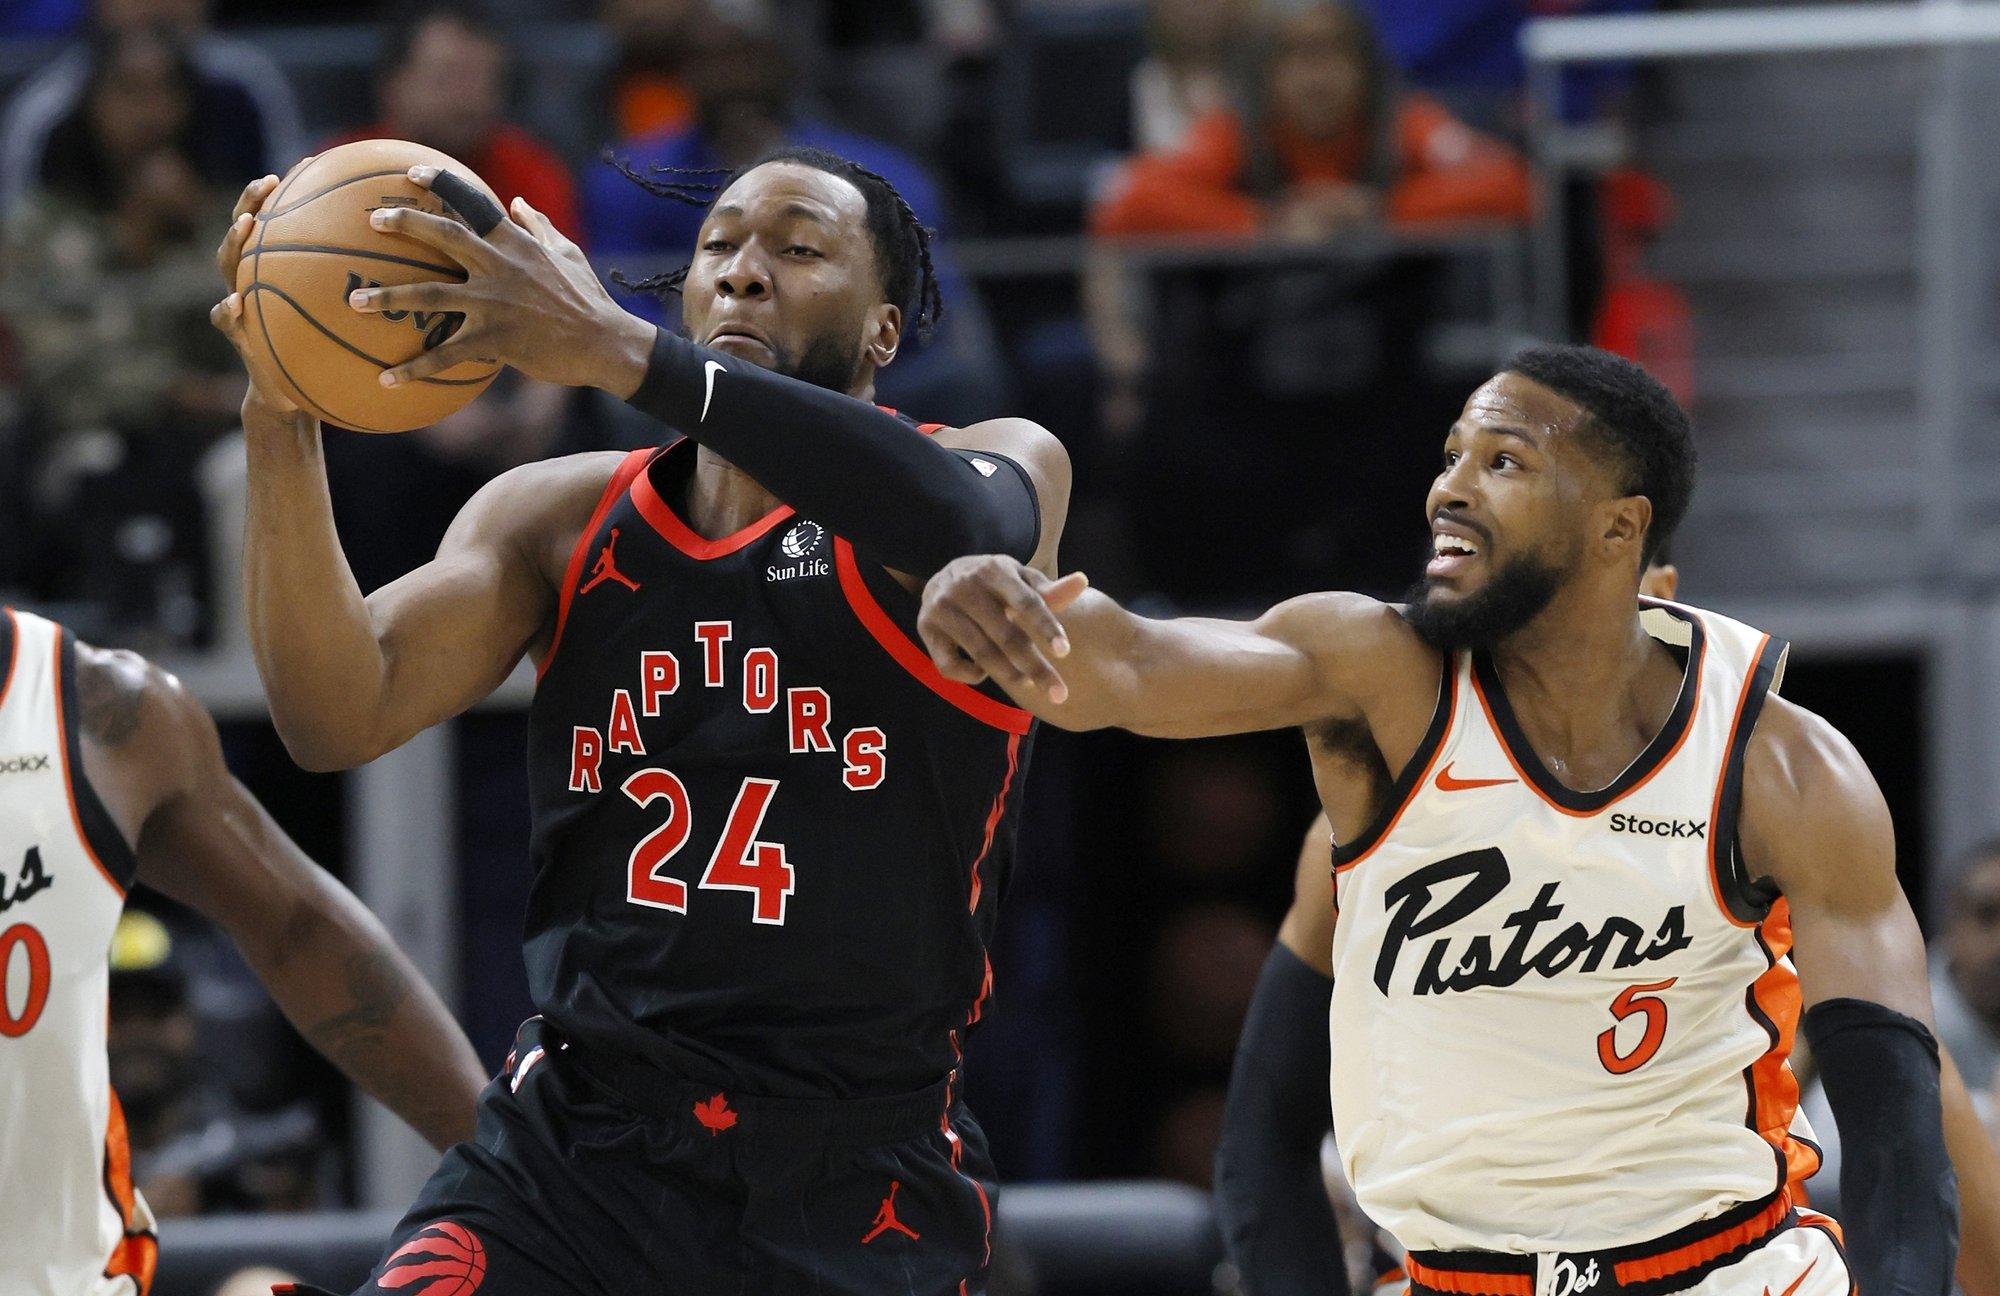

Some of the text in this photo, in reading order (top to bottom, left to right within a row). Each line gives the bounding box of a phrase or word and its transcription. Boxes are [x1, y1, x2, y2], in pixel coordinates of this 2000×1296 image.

[766, 558, 828, 582] Sun Life
[568, 620, 887, 793] RAPTORS
[619, 767, 795, 926] 24
[1609, 813, 1706, 839] StockX
[1373, 846, 1694, 998] Pistons
[1597, 976, 1679, 1075] 5
